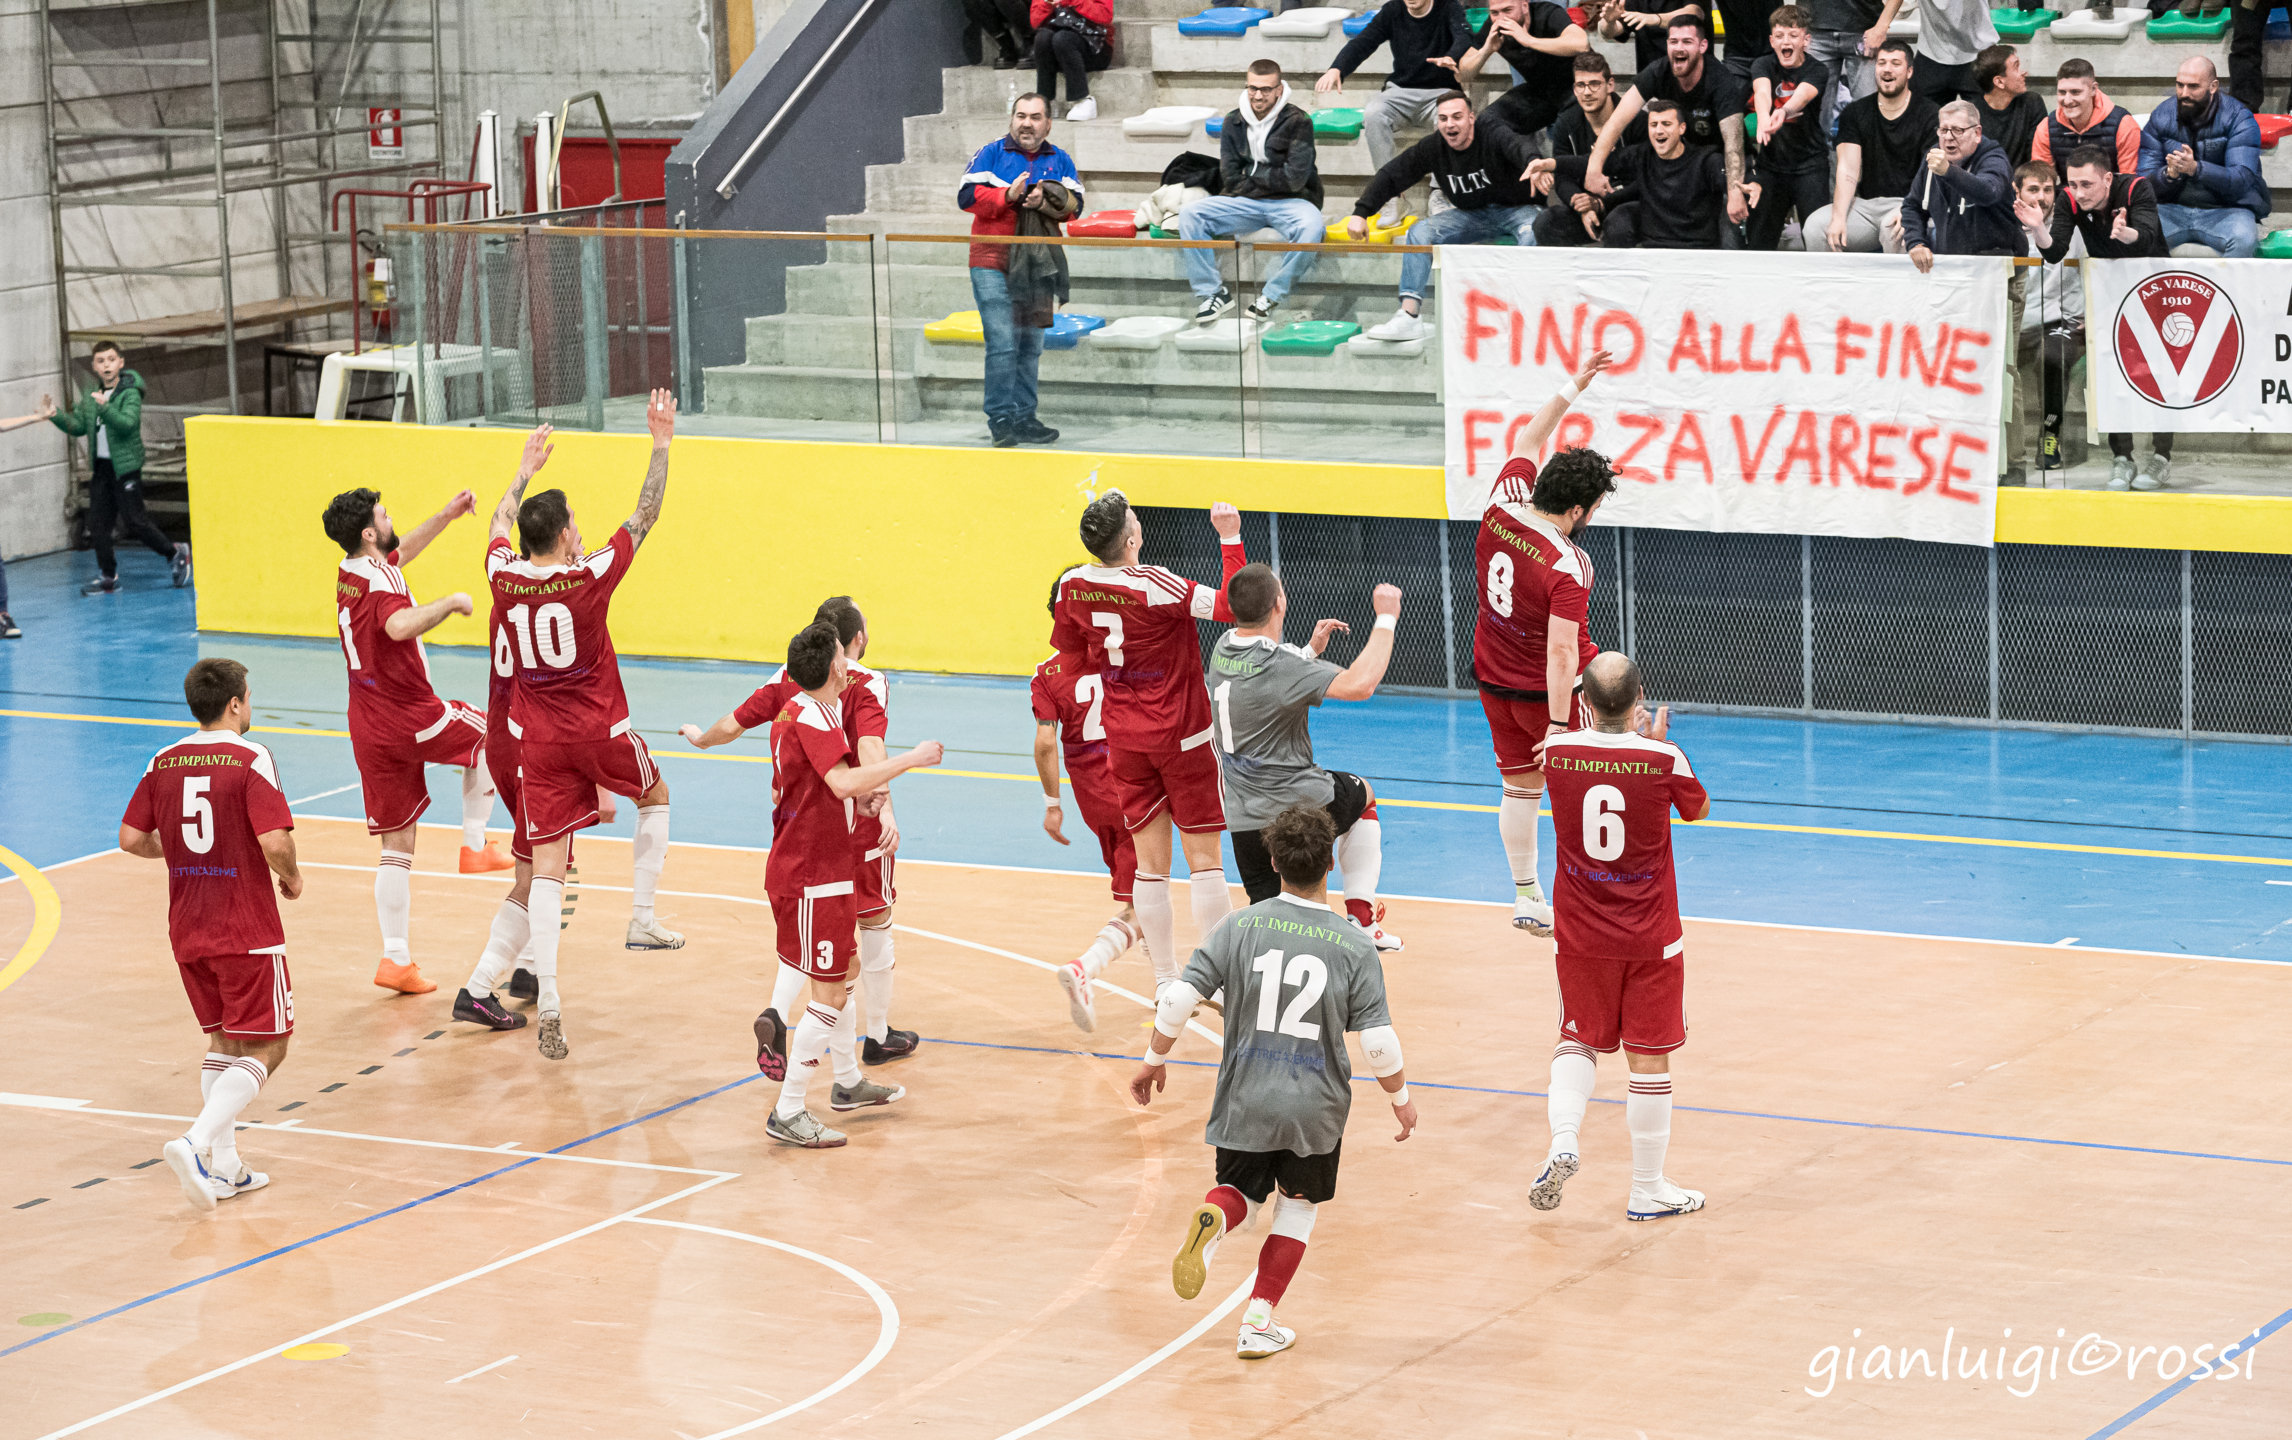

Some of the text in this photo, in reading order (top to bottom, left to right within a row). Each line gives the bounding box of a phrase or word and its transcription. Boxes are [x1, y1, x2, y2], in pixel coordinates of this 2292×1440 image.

[2161, 296, 2192, 307] 1910
[2163, 279, 2213, 300] VARESE
[1463, 288, 1992, 396] FINO ALLA FINE
[1729, 403, 1990, 505] VARESE
[1486, 551, 1515, 618] 8
[507, 602, 577, 669] 10
[1091, 611, 1124, 667] 7
[1075, 673, 1107, 741] 2
[1213, 680, 1235, 754] 1
[181, 775, 214, 854] 5
[1582, 784, 1626, 862] 6
[816, 940, 834, 970] 3
[1252, 948, 1328, 1041] 12
[1369, 1047, 1385, 1060] DX
